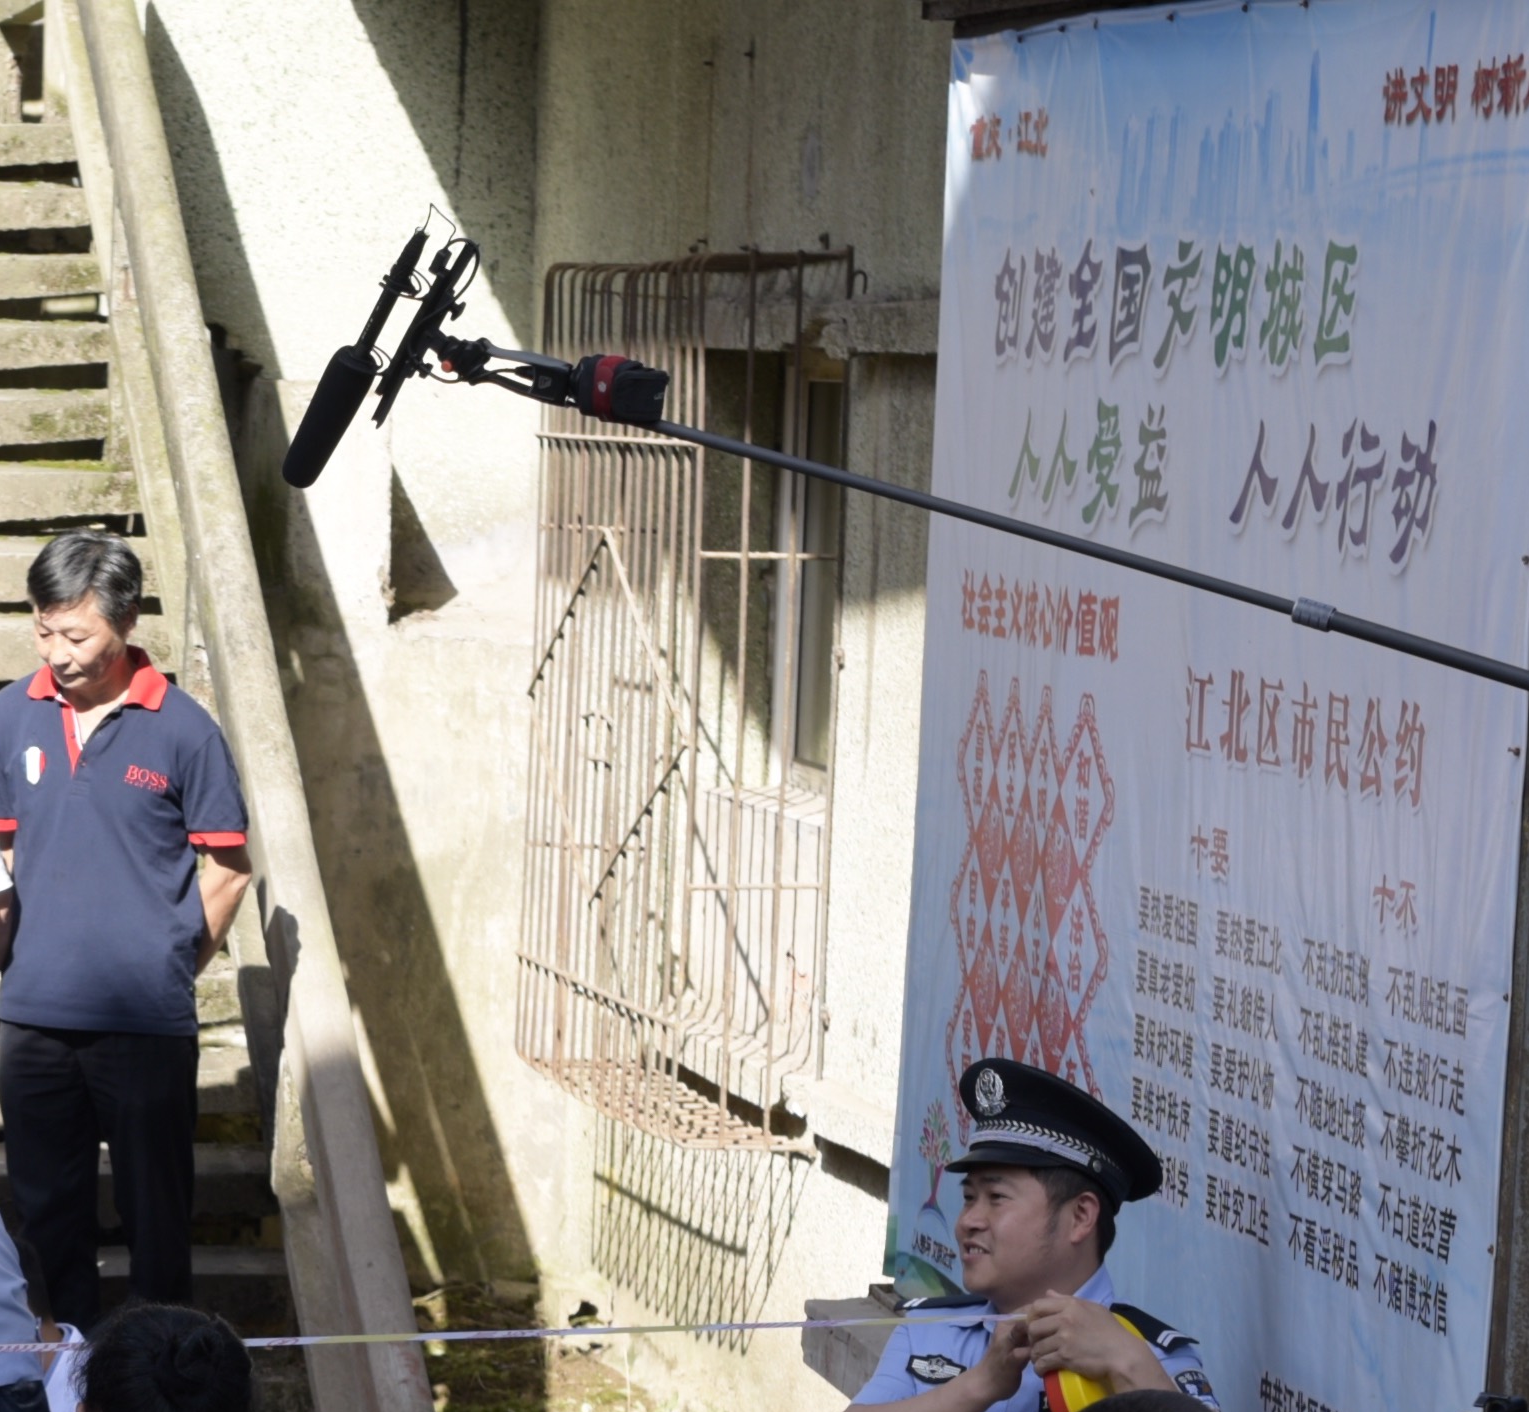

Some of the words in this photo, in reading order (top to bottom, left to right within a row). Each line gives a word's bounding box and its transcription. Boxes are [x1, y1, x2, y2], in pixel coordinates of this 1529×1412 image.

[1383, 63, 1458, 125] 讲文明
[994, 238, 1358, 370] 创建全国文明城区
[1007, 397, 1169, 528] 人人受益
[1229, 417, 1439, 564] 人人行动
[961, 569, 1120, 663] 社会主义核心价值观
[126, 764, 168, 789] BOSS
[1184, 665, 1425, 807] 江北区市民公约
[1190, 824, 1229, 876] 十要
[1139, 886, 1198, 950] 要热爱祖国
[1215, 910, 1282, 975] 要热爱江北
[1373, 874, 1418, 929] 十不
[1136, 949, 1196, 1013] 要尊老爱幼
[1213, 976, 1278, 1041] 要礼貌待人
[1301, 937, 1369, 1007] 不乱扔乱倒
[1386, 966, 1469, 1040] 不乱贴乱画
[1134, 1013, 1194, 1080] 要保护环境
[1210, 1043, 1274, 1110] 要爱护公物
[1298, 1007, 1369, 1079] 不乱搭乱建
[1383, 1037, 1465, 1116] 不违规行走
[1132, 1077, 1191, 1143] 要维护秩序
[1208, 1108, 1270, 1179] 要遵纪守法
[1295, 1076, 1365, 1150] 不随地吐痰
[1380, 1110, 1462, 1187] 不攀折花木
[1205, 1174, 1269, 1247] 要讲究卫生
[1290, 1144, 1362, 1221] 不横穿马路
[1377, 1182, 1457, 1265] 不占道经营
[1288, 1212, 1359, 1290] 不看淫秽品
[1373, 1252, 1448, 1336] 不赌博迷信
